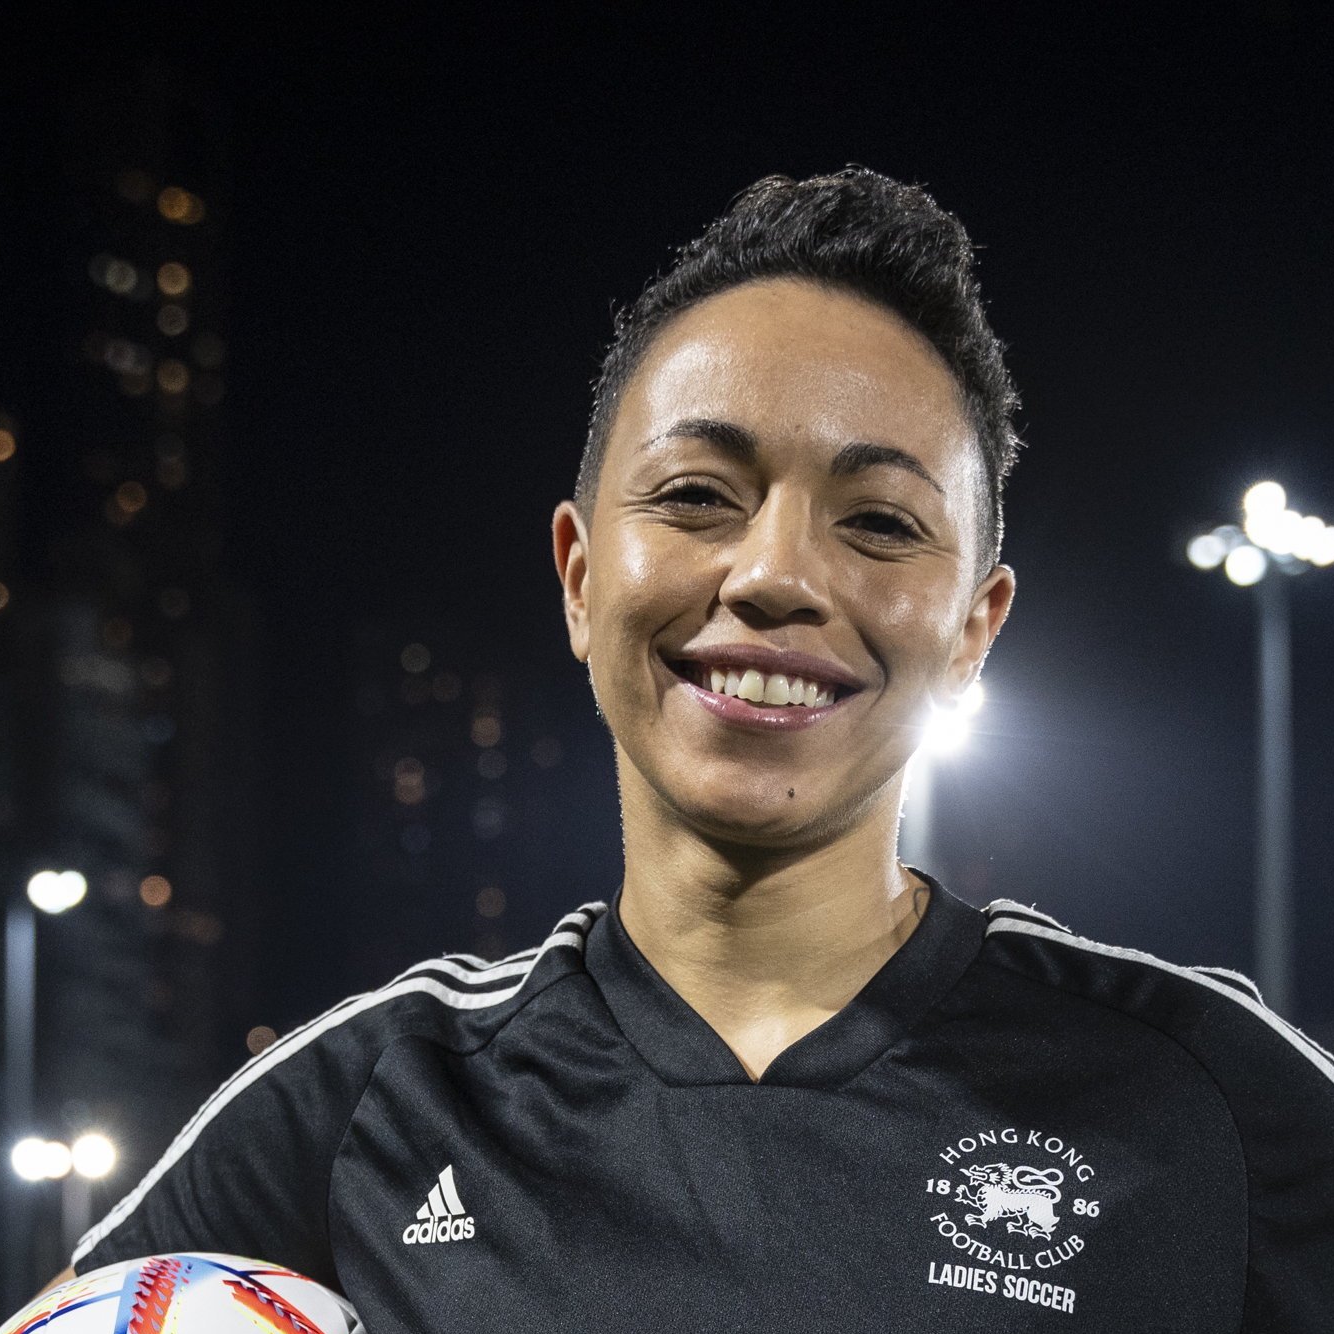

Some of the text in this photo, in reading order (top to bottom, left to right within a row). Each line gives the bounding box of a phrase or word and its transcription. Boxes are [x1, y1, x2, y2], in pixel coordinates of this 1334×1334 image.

[939, 1128, 1095, 1183] HONG KONG
[925, 1178, 1100, 1218] 18 86
[402, 1213, 475, 1245] adidas
[930, 1212, 1085, 1270] FOOTBALL CLUB
[927, 1261, 1076, 1314] LADIES SOCCER
